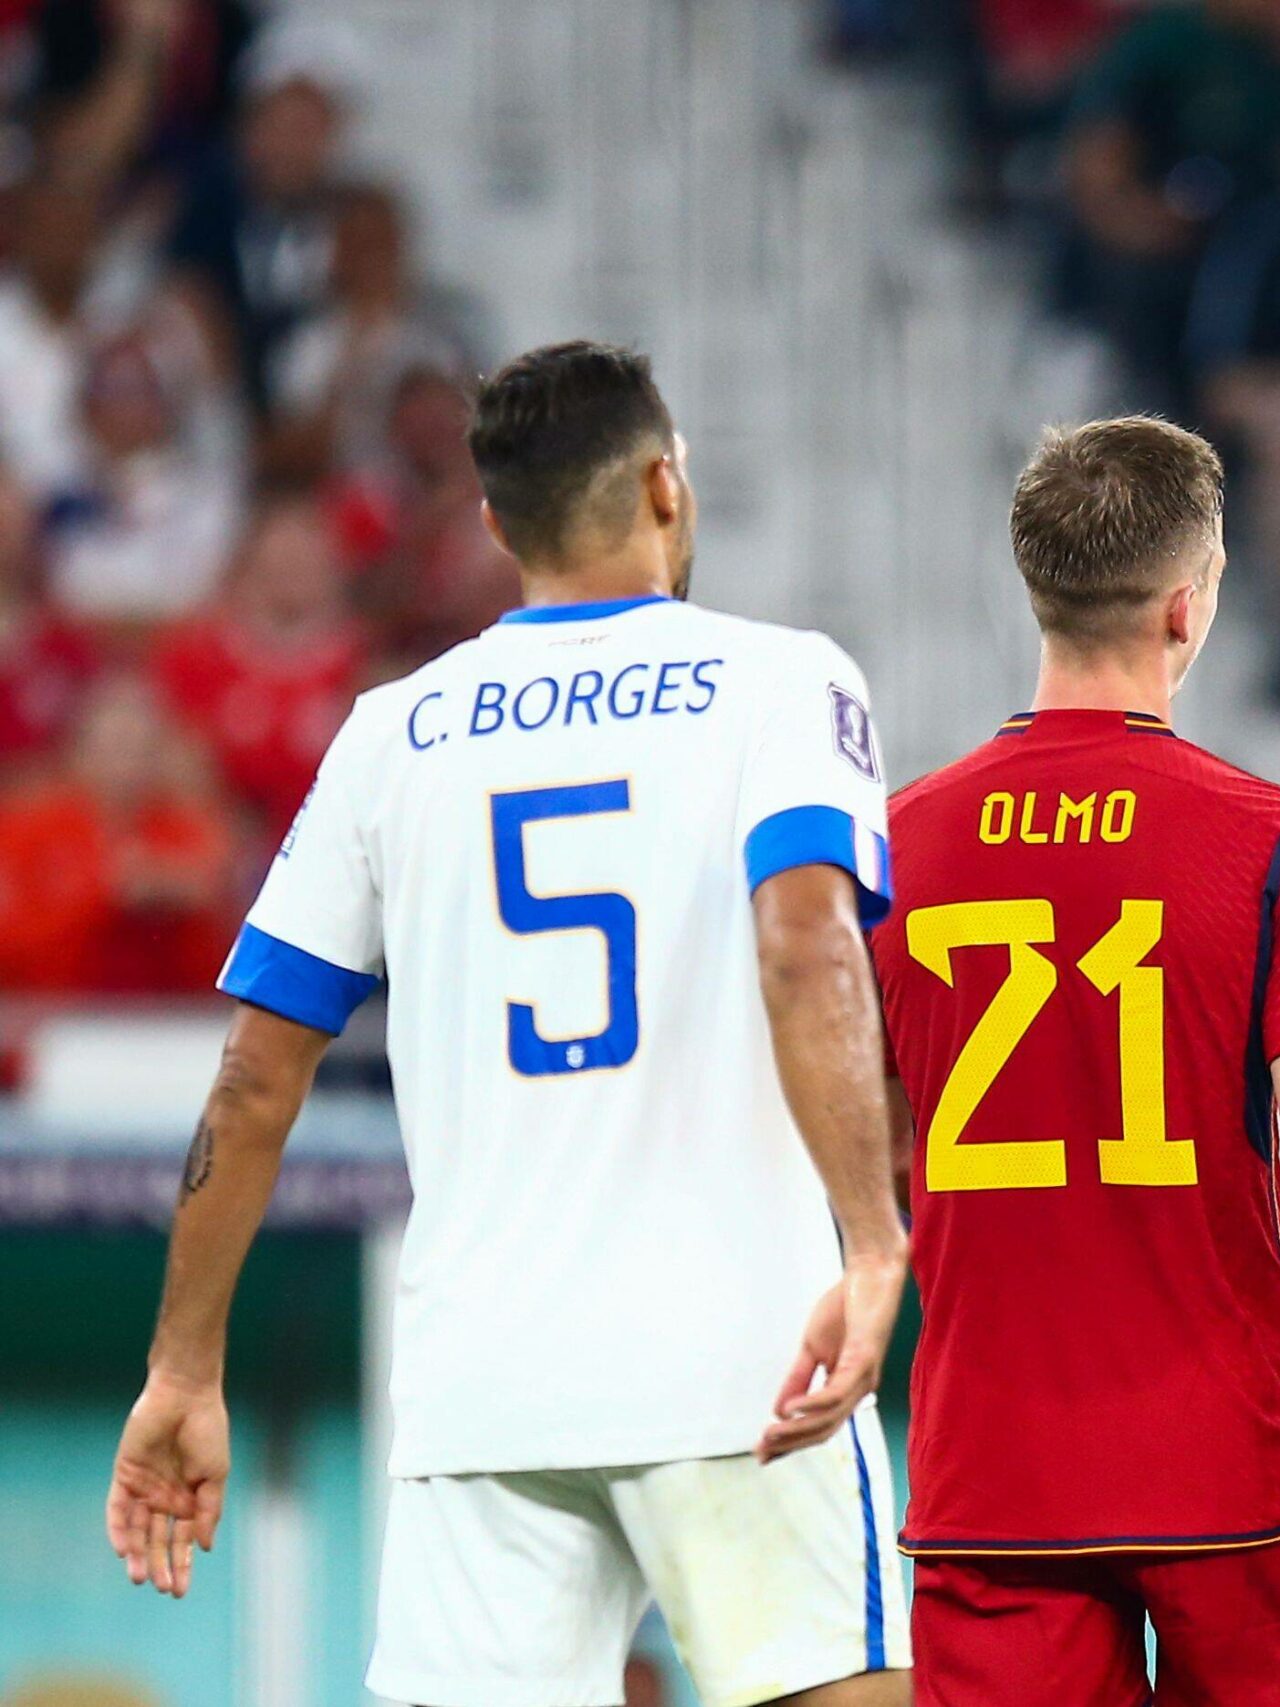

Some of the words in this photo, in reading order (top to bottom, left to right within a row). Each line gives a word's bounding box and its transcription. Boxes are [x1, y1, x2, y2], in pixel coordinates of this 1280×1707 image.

[407, 691, 448, 751] C.
[467, 658, 724, 737] BORGES
[978, 789, 1137, 845] OLMO
[488, 777, 640, 1078] 5
[905, 898, 1198, 1193] 21
